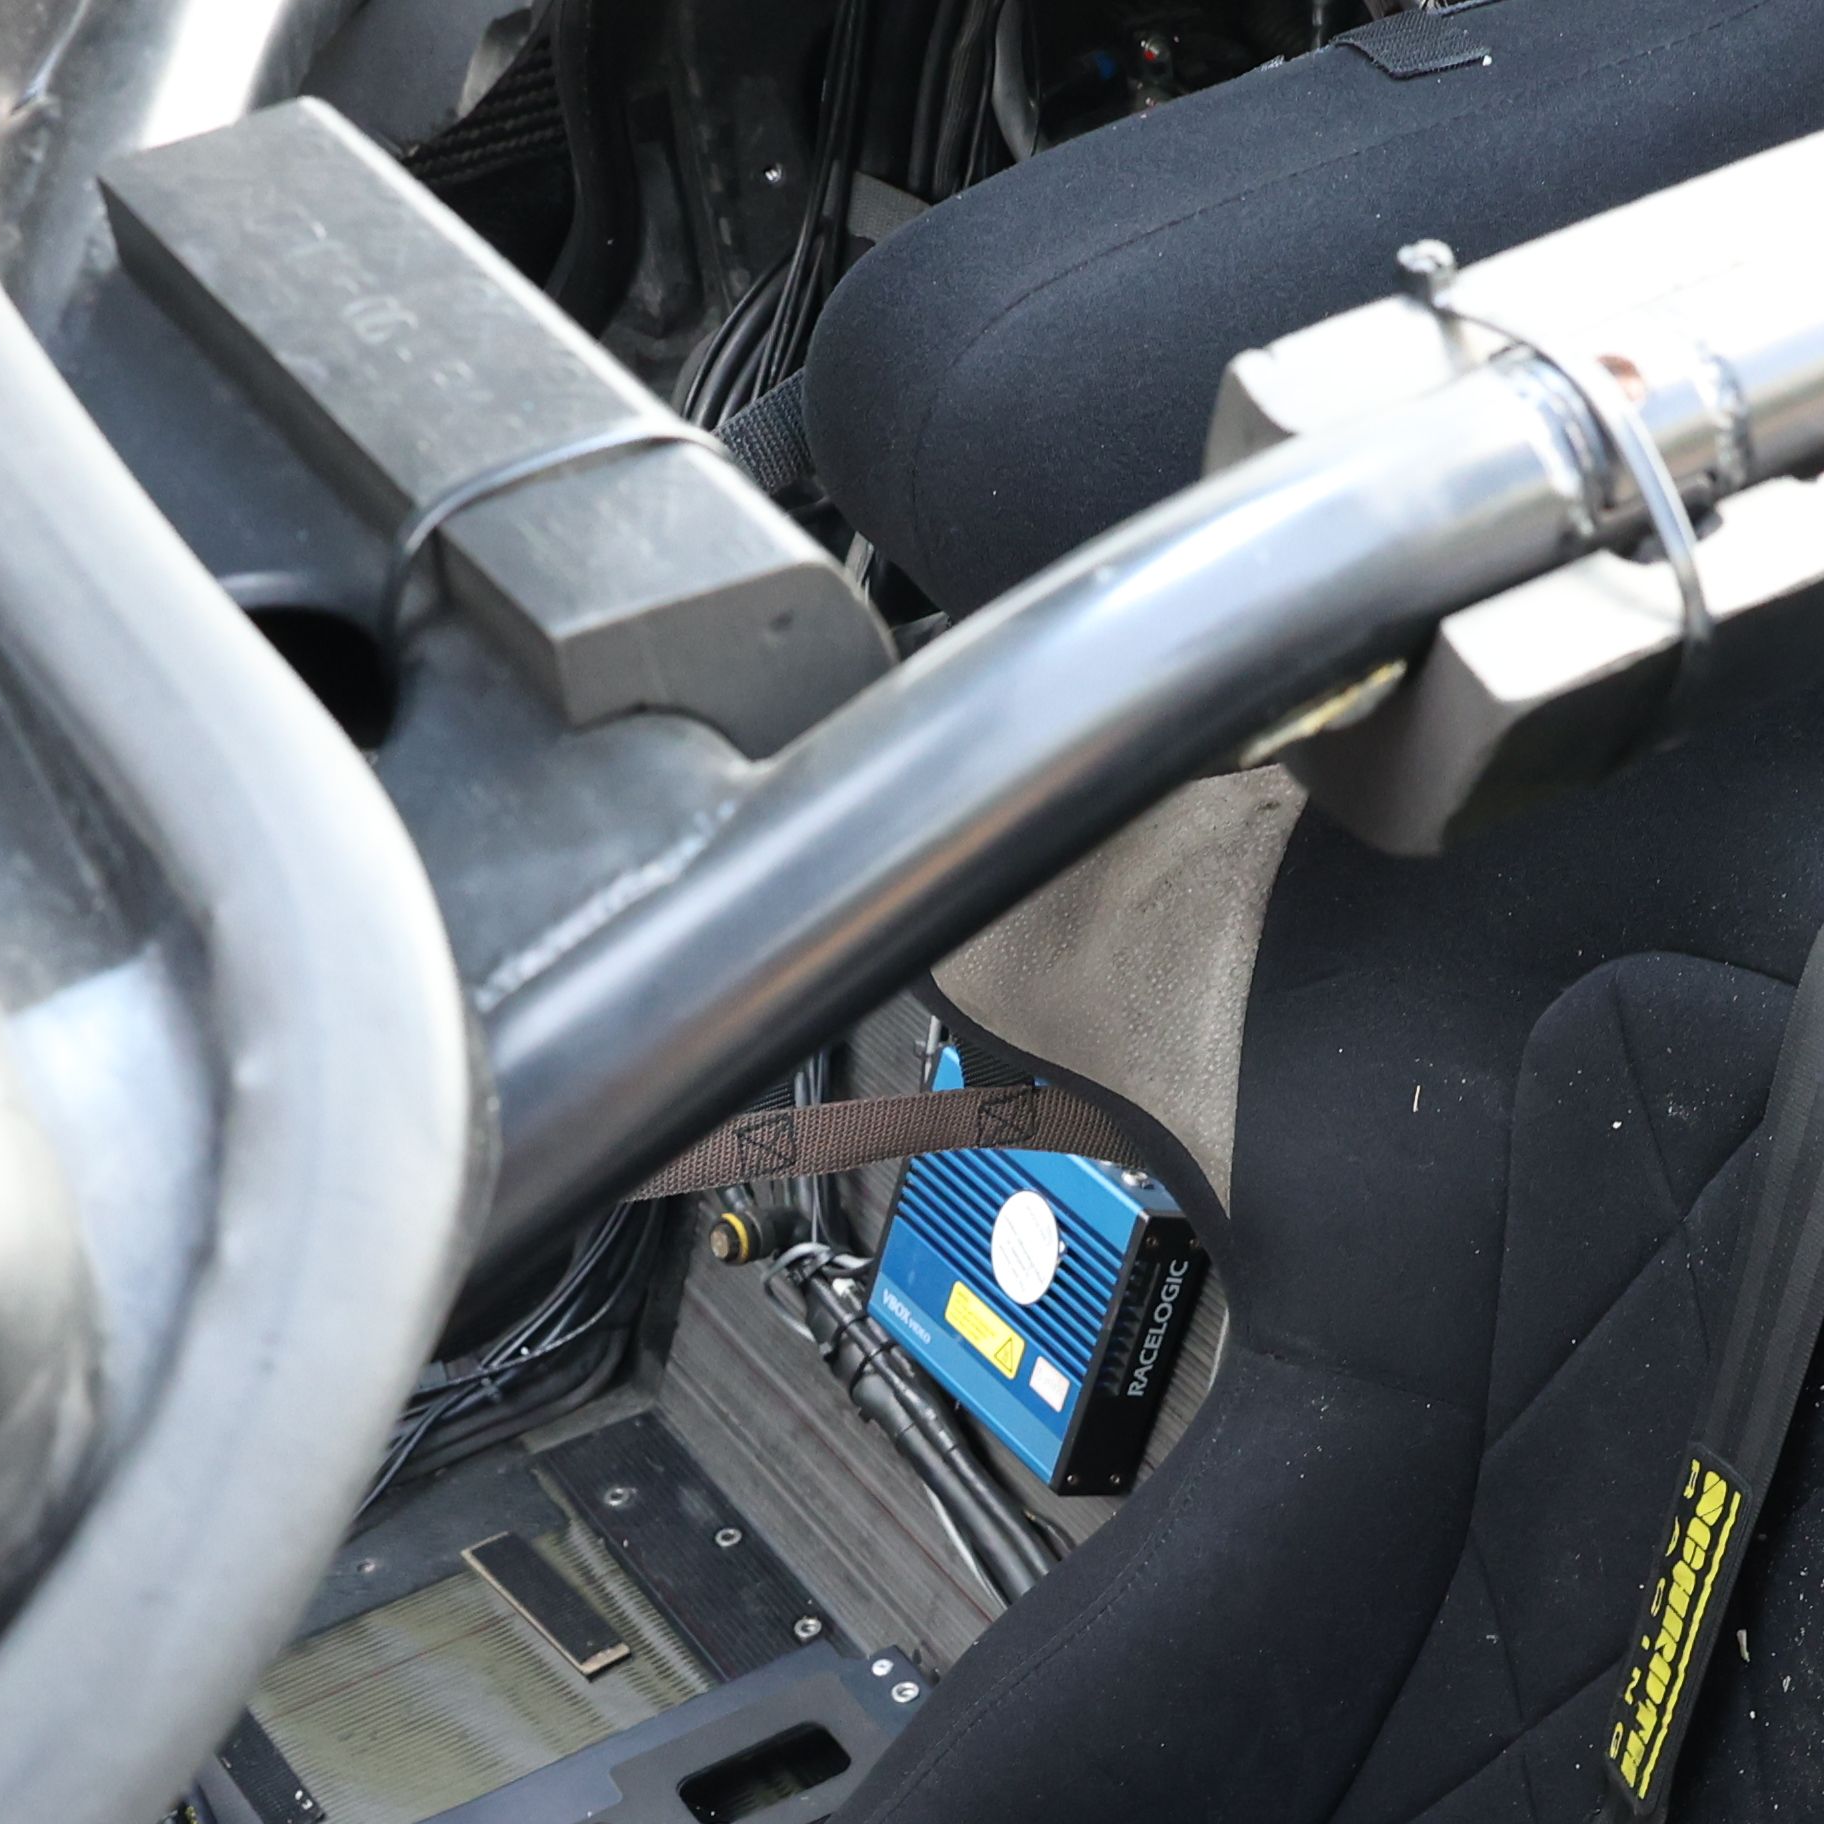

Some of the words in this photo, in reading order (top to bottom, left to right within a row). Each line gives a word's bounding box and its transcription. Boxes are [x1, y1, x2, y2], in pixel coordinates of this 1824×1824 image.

[882, 1289, 910, 1324] VBOX
[1127, 1260, 1189, 1398] RACELOGIC
[1607, 1459, 1700, 1758] RACING
[1619, 1470, 1728, 1787] SCHROTH
